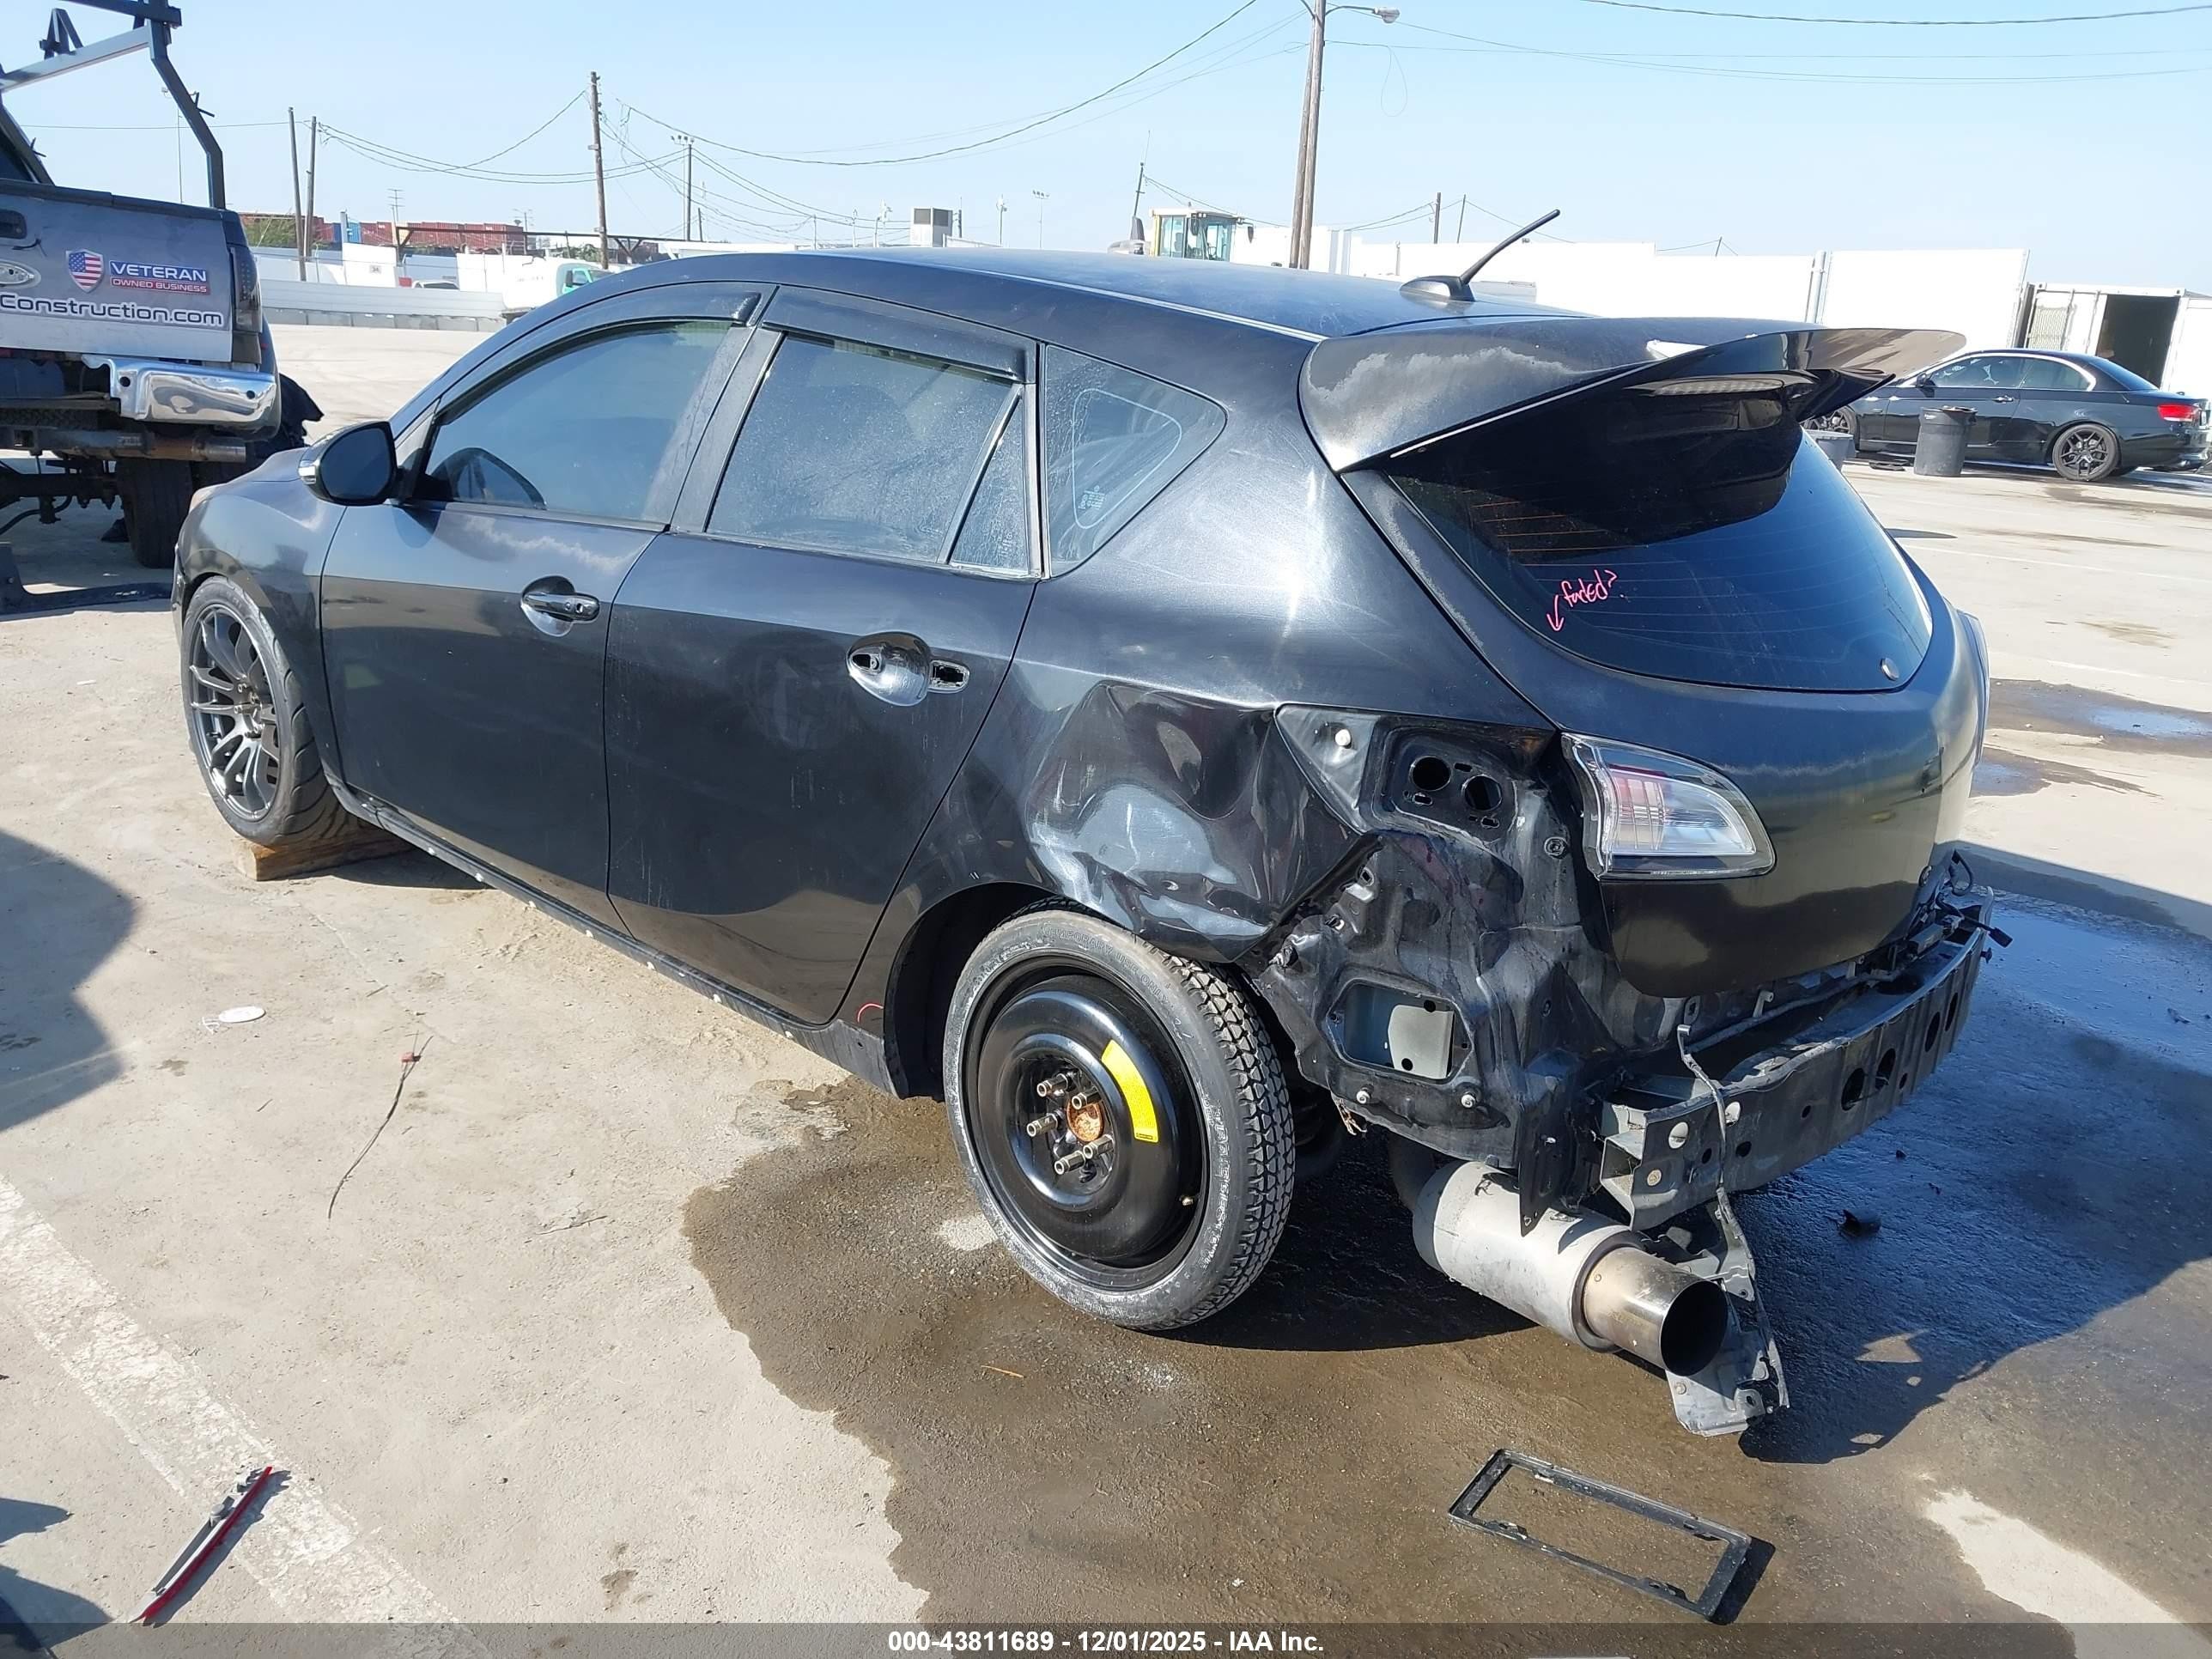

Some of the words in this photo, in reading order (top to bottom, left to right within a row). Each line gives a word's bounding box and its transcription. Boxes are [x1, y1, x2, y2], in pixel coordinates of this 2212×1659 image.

[112, 263, 207, 282] VETERAN
[112, 279, 153, 289] OWNED
[155, 283, 207, 293] BUSINESS
[0, 294, 222, 325] Construction.com
